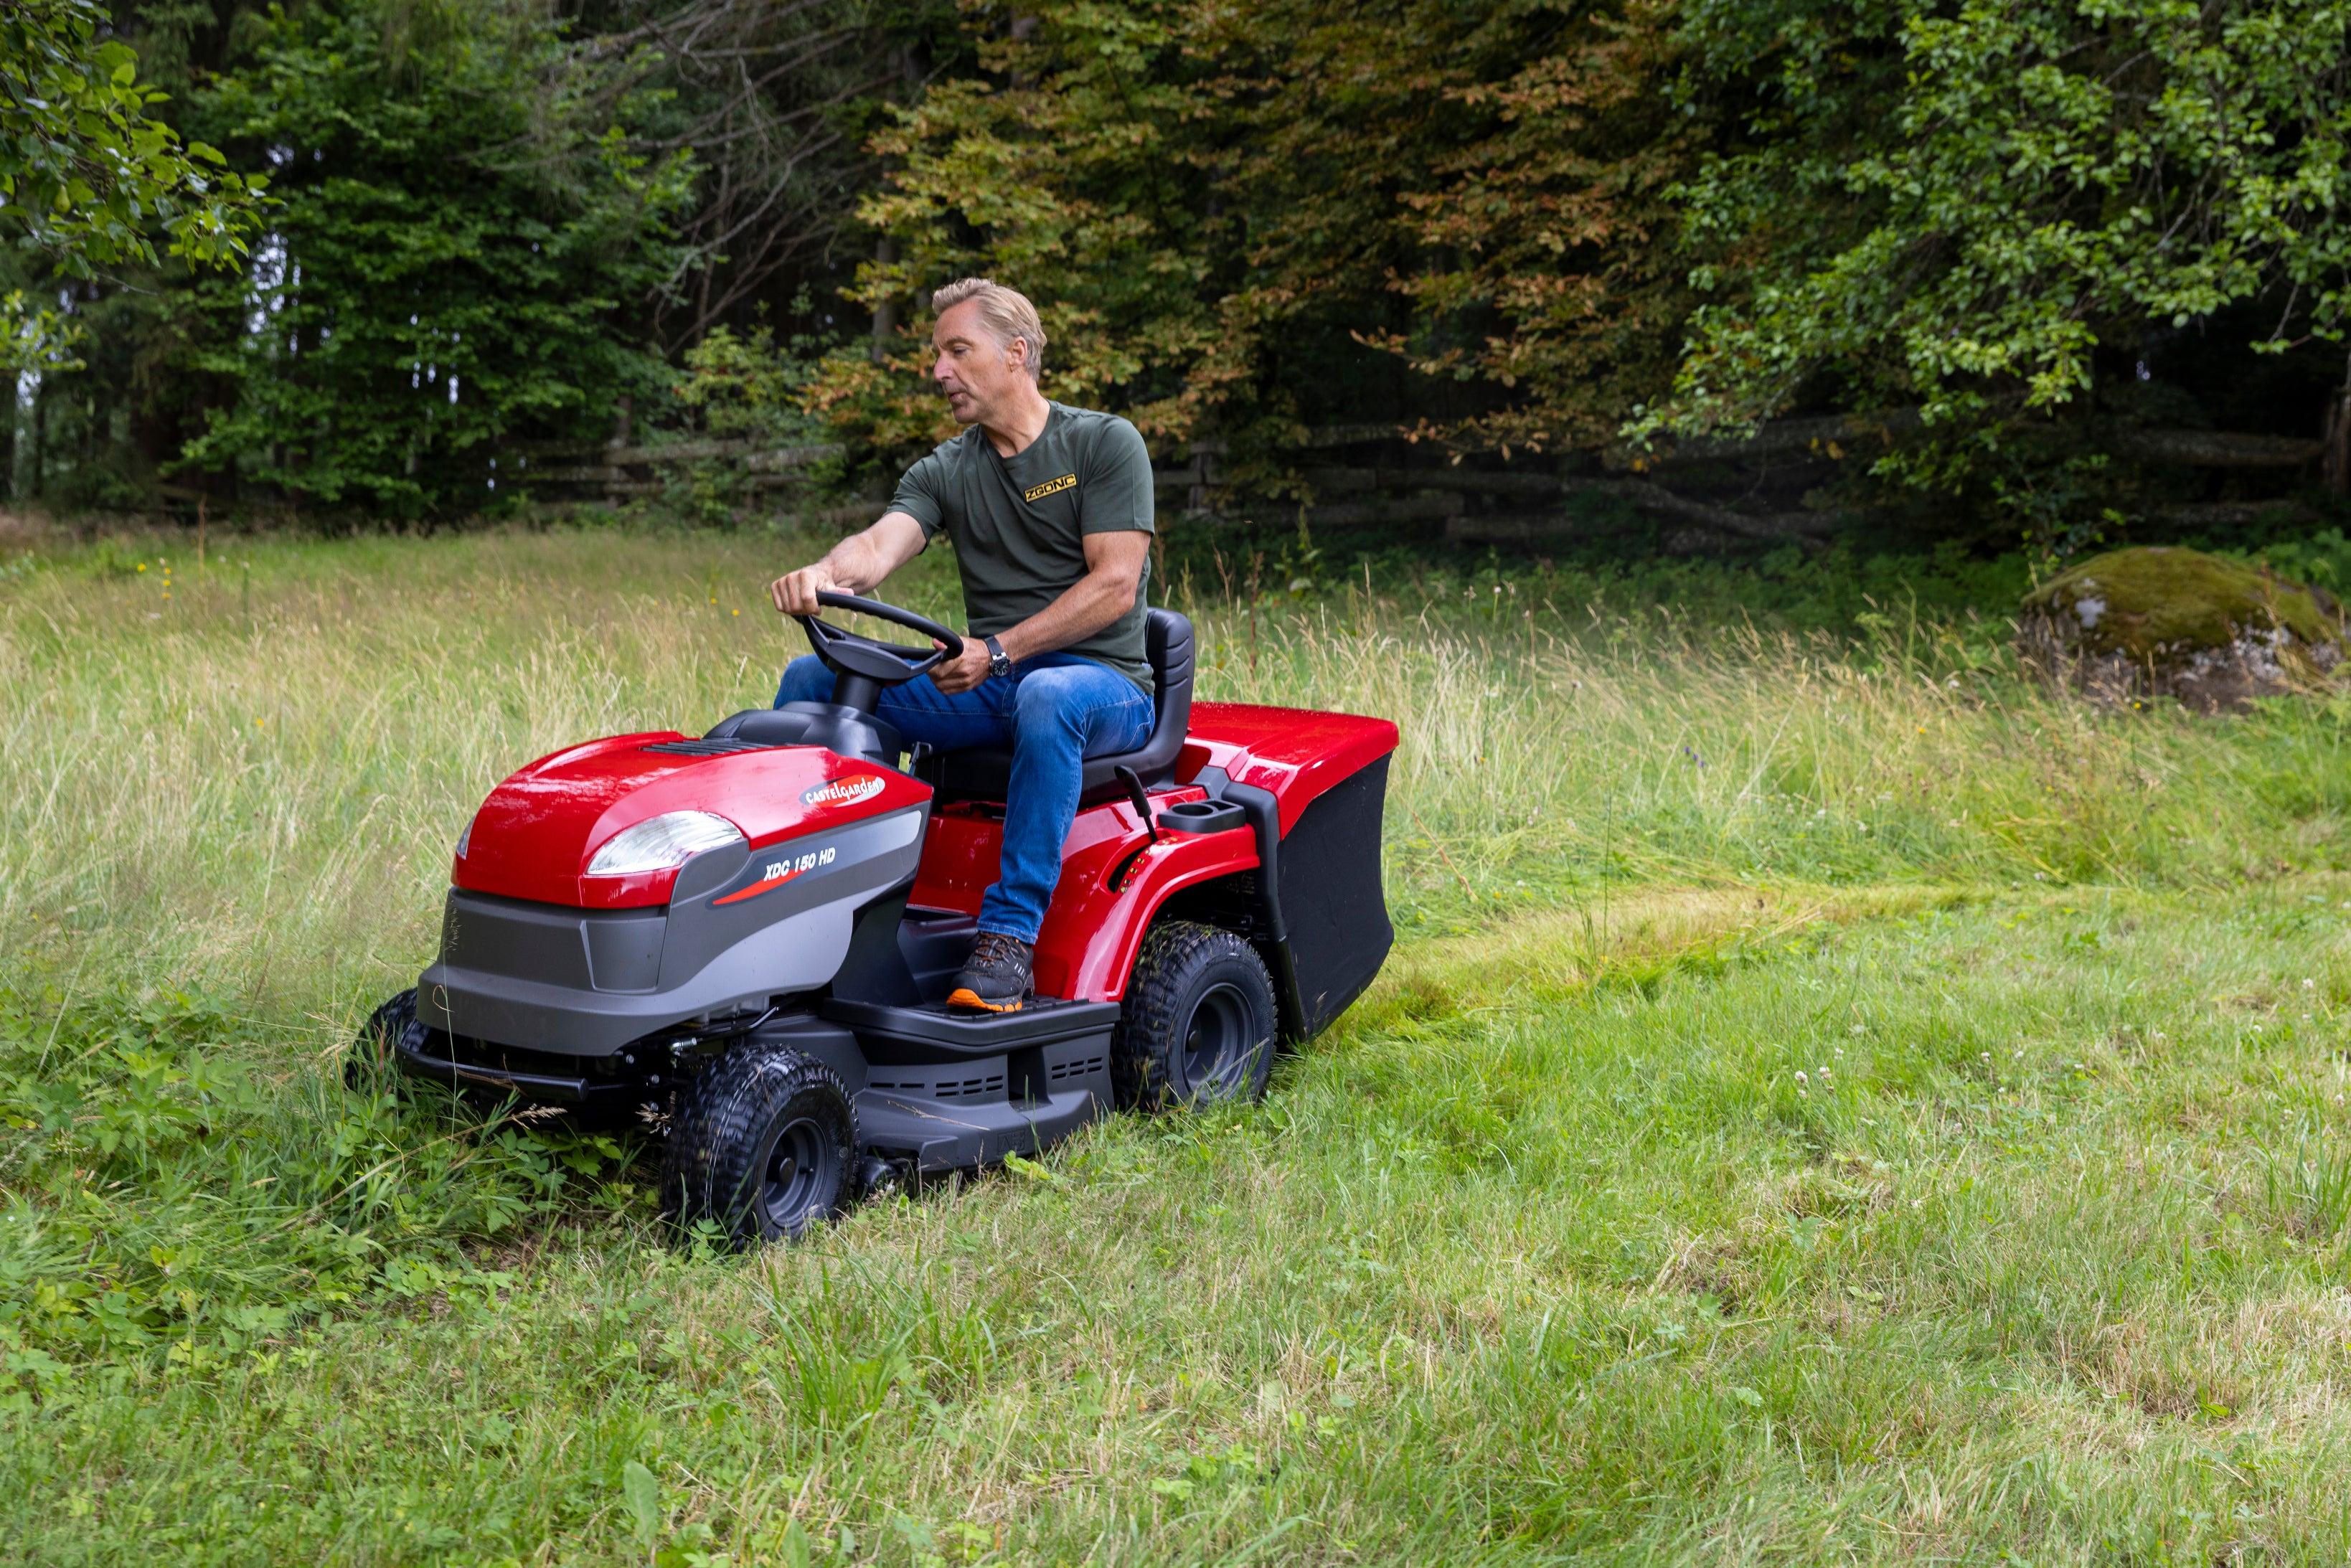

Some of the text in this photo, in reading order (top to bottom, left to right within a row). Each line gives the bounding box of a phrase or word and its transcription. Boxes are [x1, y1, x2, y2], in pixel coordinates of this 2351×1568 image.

[1026, 476, 1075, 500] ZGONC
[763, 847, 836, 882] XDC 150 HD
